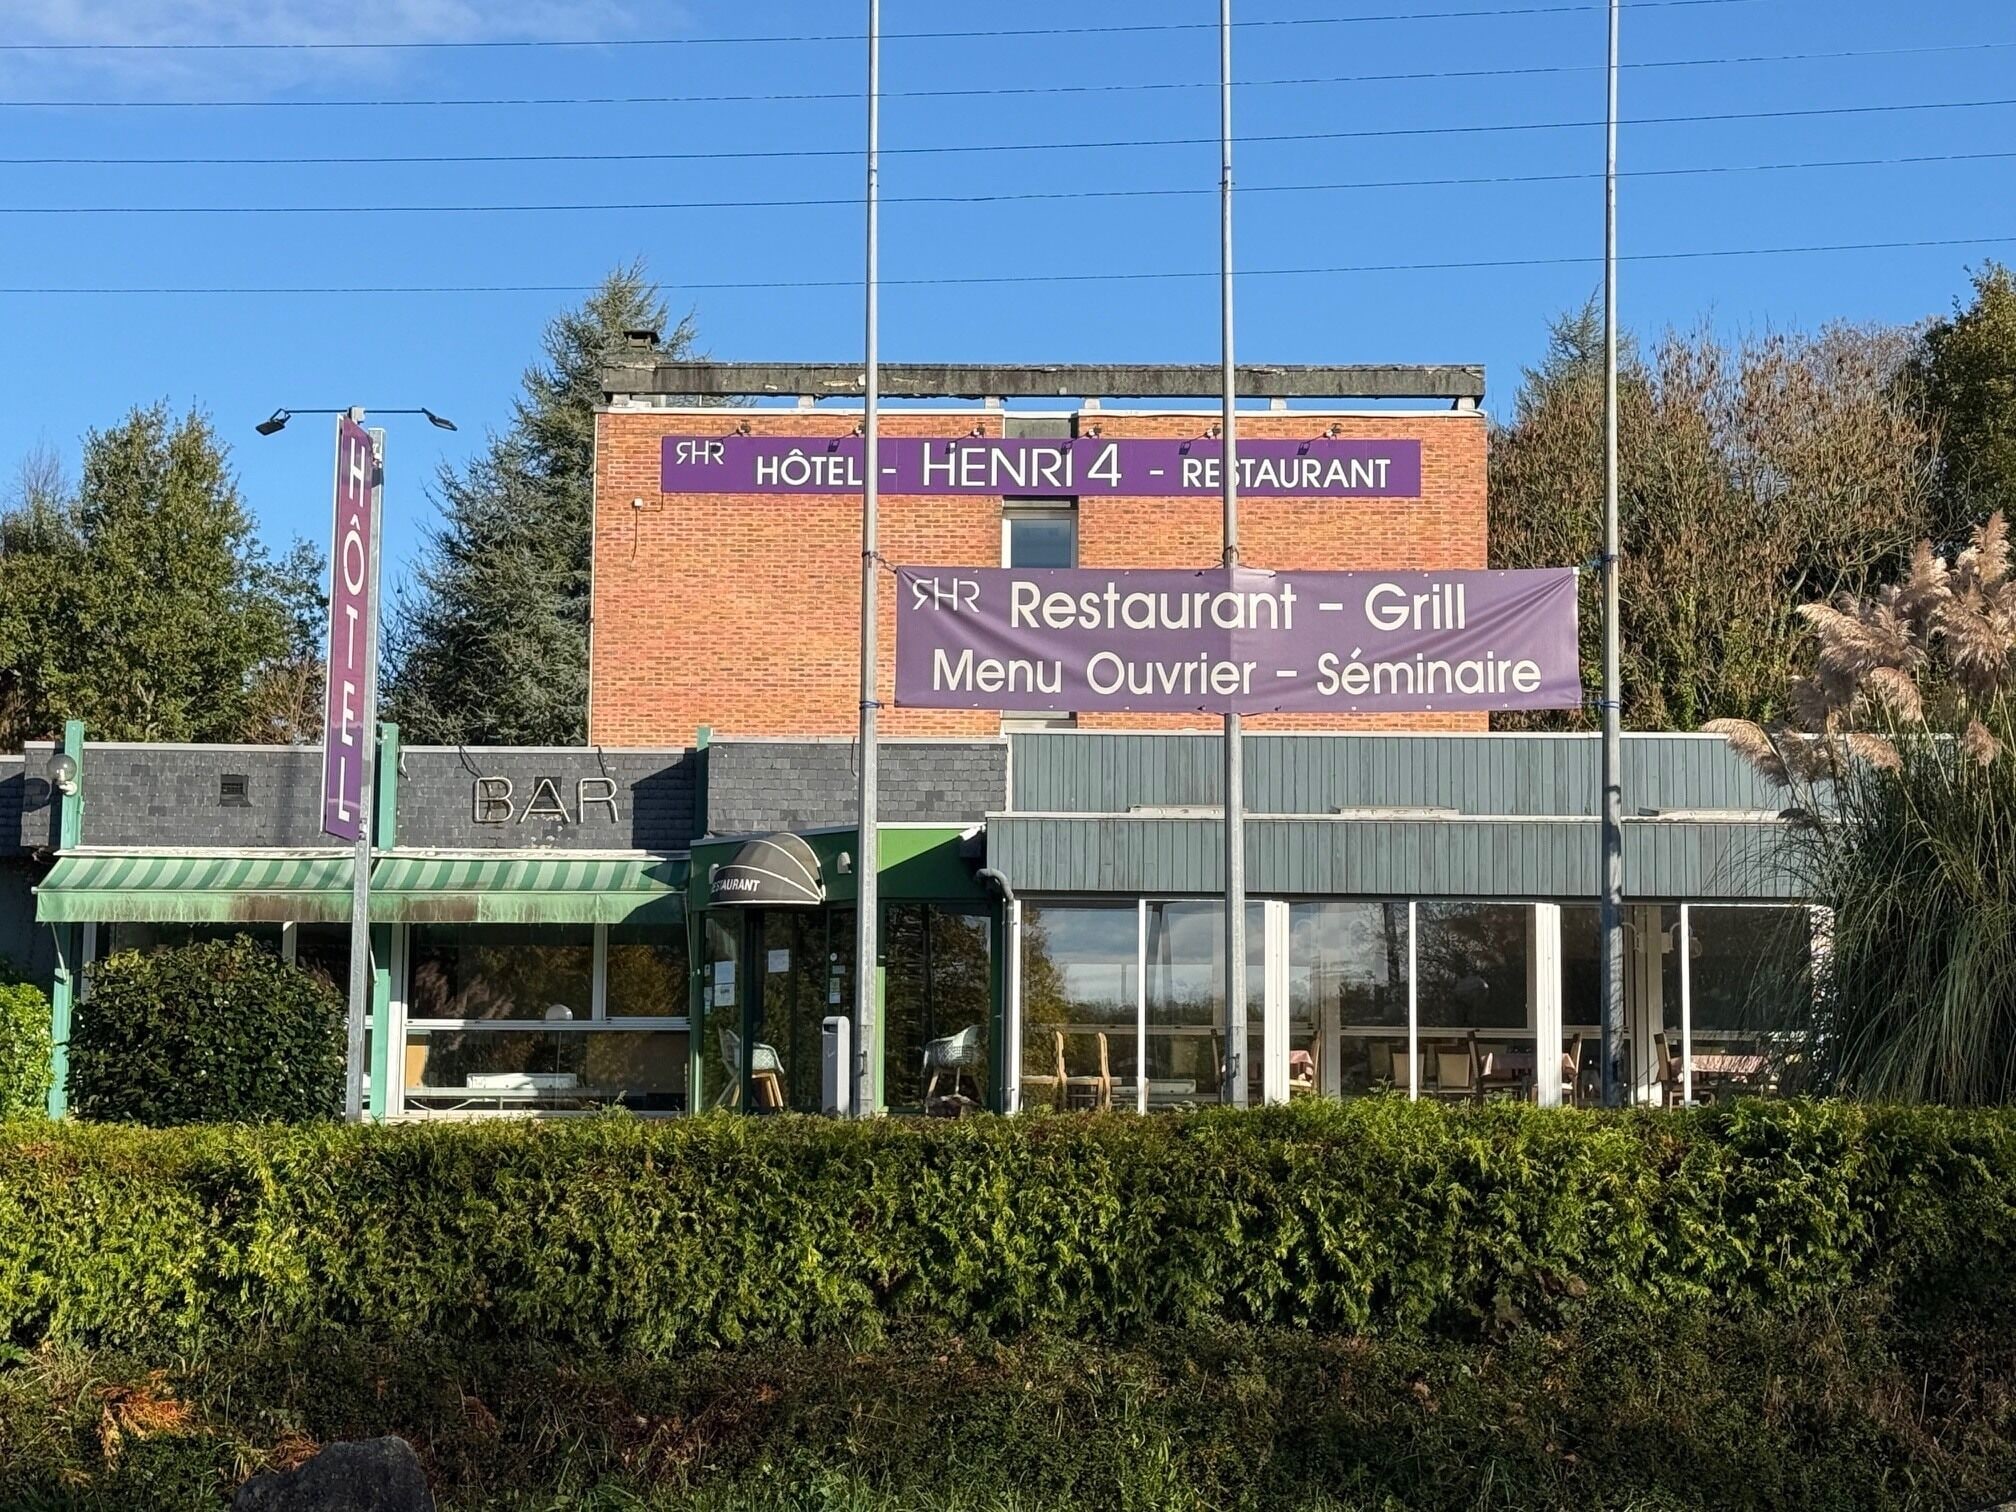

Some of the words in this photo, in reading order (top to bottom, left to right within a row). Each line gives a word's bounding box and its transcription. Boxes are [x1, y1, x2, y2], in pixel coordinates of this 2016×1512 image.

[757, 448, 863, 486] HÔTEL
[923, 442, 1073, 487] HENRI
[1087, 443, 1122, 487] 4
[339, 437, 366, 822] HÔTEL
[1011, 582, 1298, 630] Restaurant
[1318, 602, 1344, 611] -
[1364, 583, 1466, 631] Grill
[933, 648, 1062, 694] Menu
[1086, 651, 1257, 695] Ouvrier
[1275, 670, 1298, 678] -
[1316, 647, 1542, 695] Séminaire
[474, 776, 619, 823] BAR
